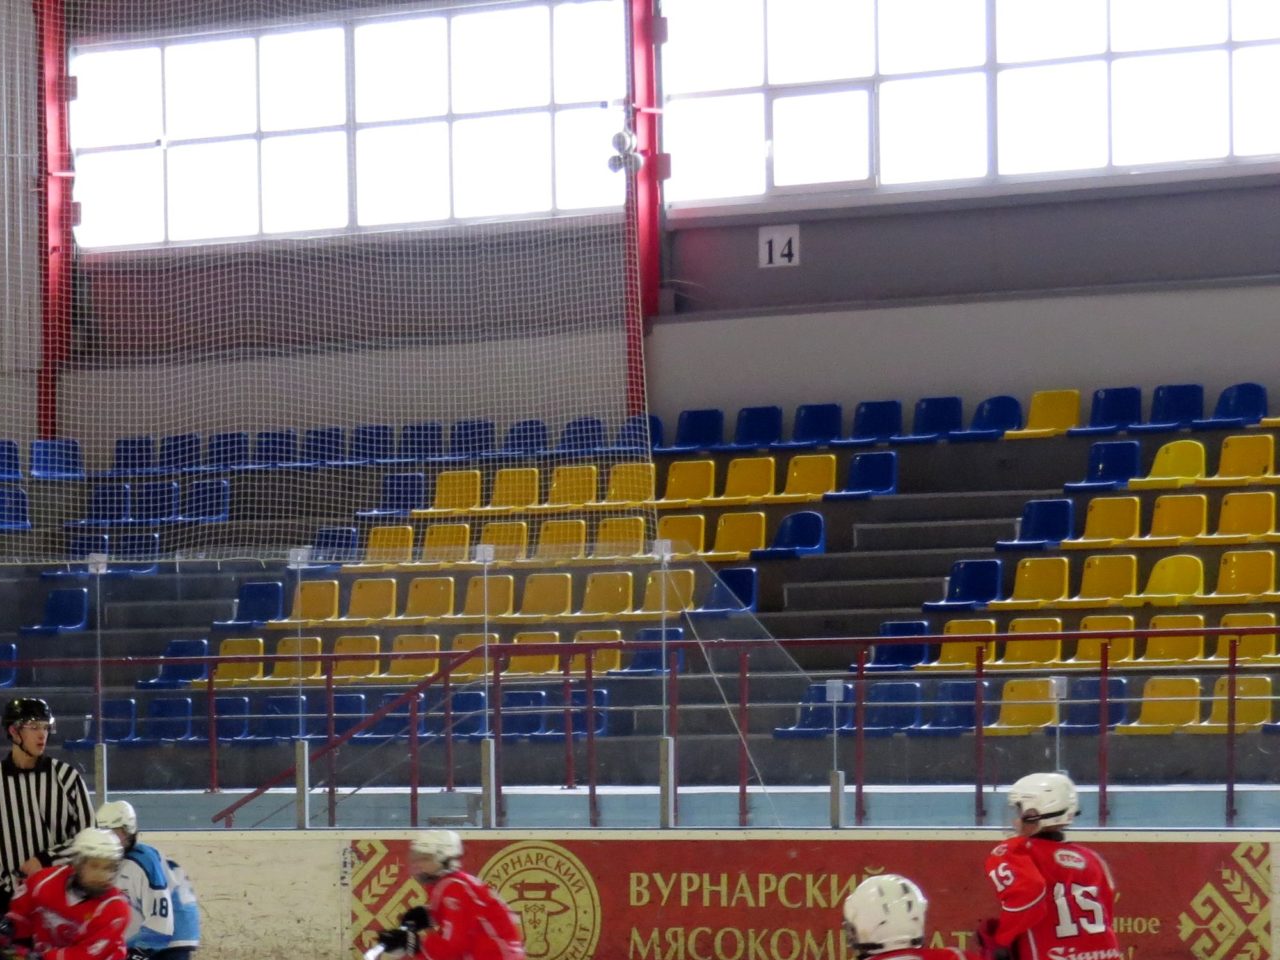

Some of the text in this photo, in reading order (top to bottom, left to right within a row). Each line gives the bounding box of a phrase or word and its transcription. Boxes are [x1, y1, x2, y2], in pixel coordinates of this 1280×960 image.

[765, 236, 795, 265] 14
[628, 866, 885, 909] ВУРНАРСКИ
[988, 862, 1015, 893] 15
[150, 896, 169, 918] 18
[1053, 882, 1107, 939] 15
